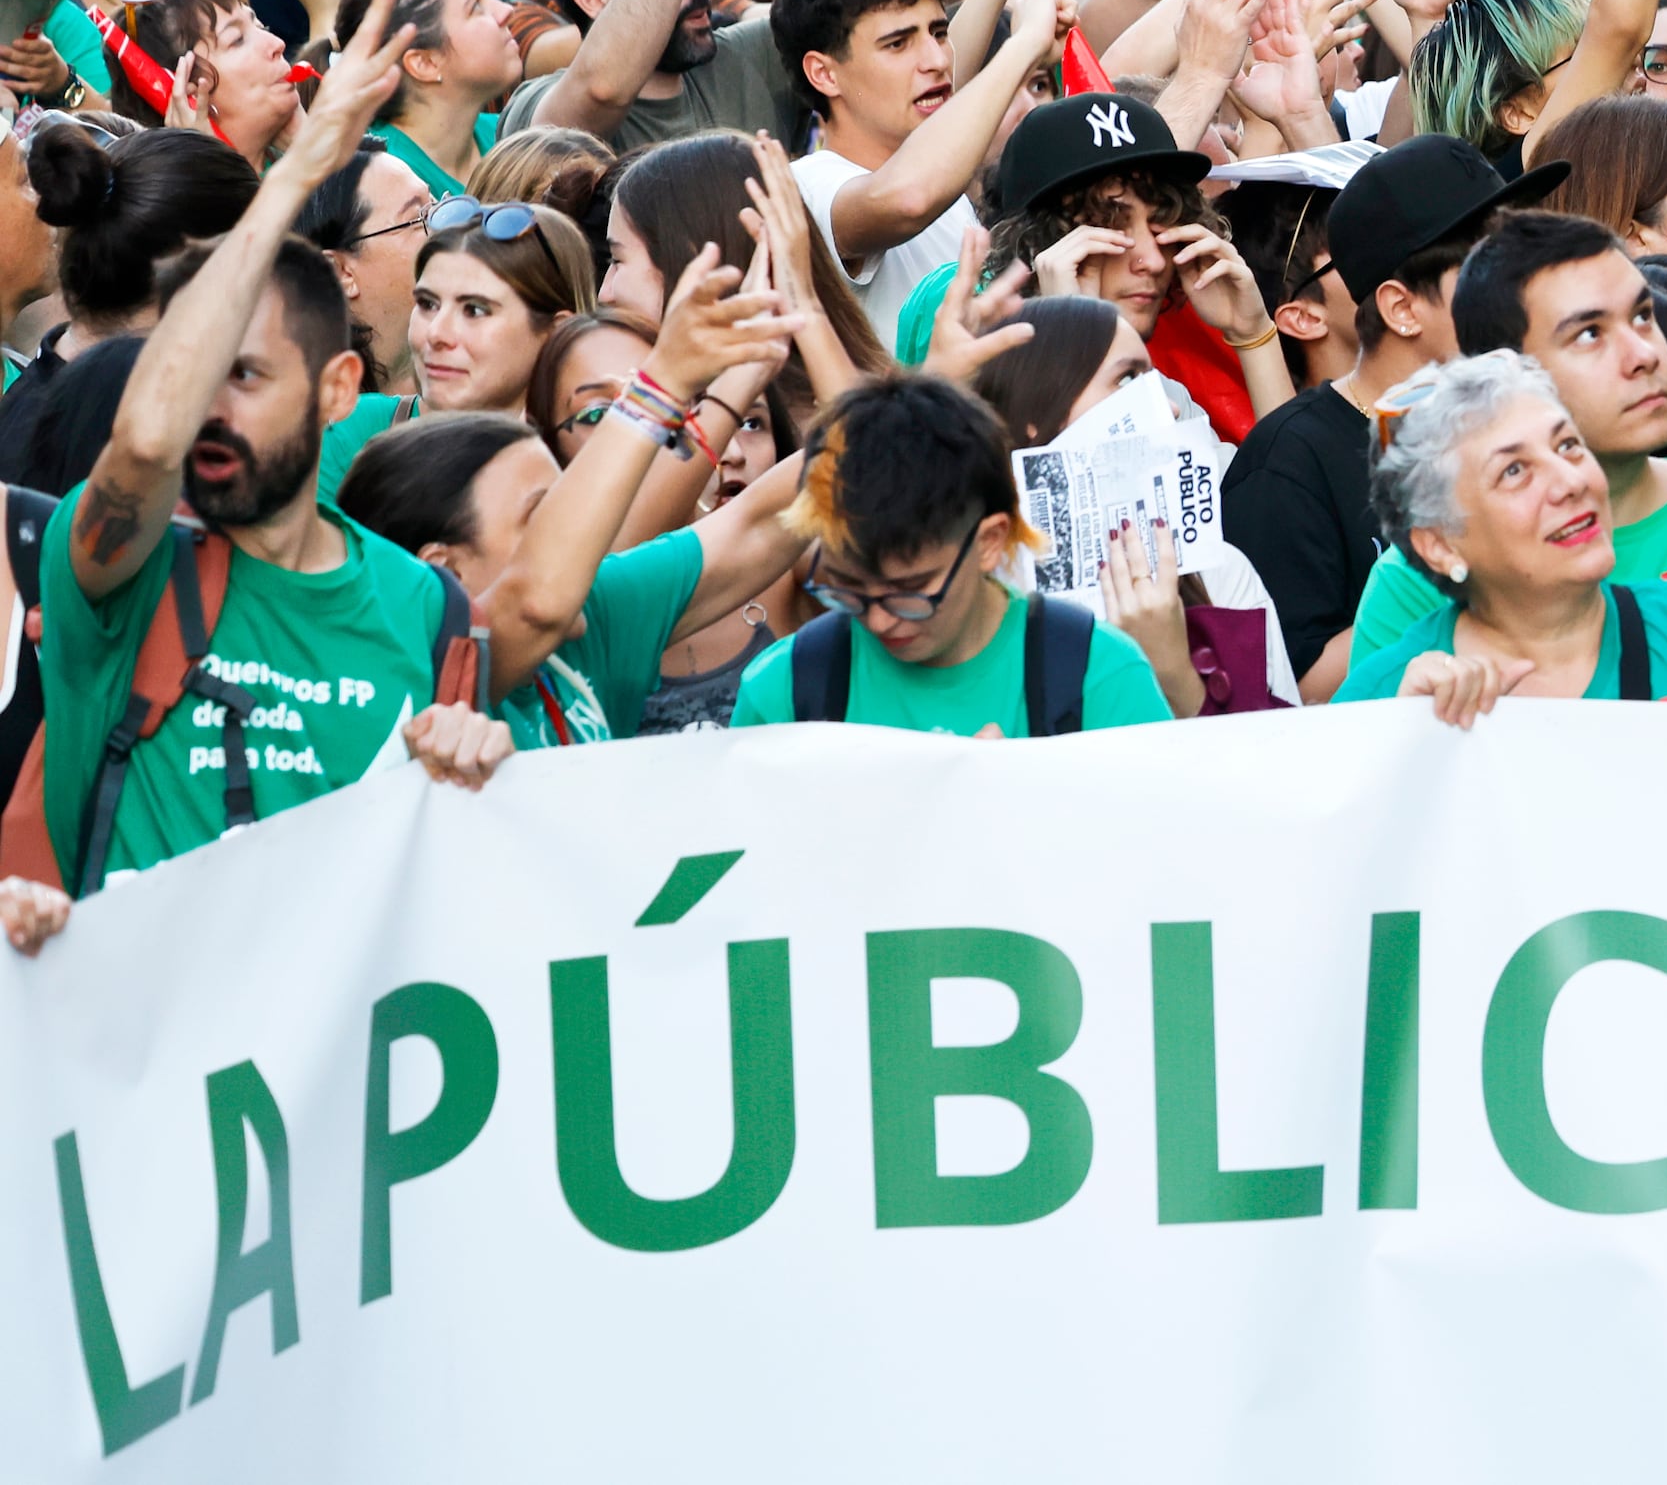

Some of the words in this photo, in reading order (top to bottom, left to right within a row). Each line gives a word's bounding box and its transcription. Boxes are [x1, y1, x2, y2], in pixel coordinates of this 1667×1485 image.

[1085, 100, 1137, 148] NY
[1177, 450, 1199, 544] PÚBLICO
[1197, 465, 1214, 524] ACTO
[338, 676, 376, 708] FP
[240, 702, 304, 732] oda
[189, 745, 260, 775] paa
[53, 1057, 303, 1460] LA
